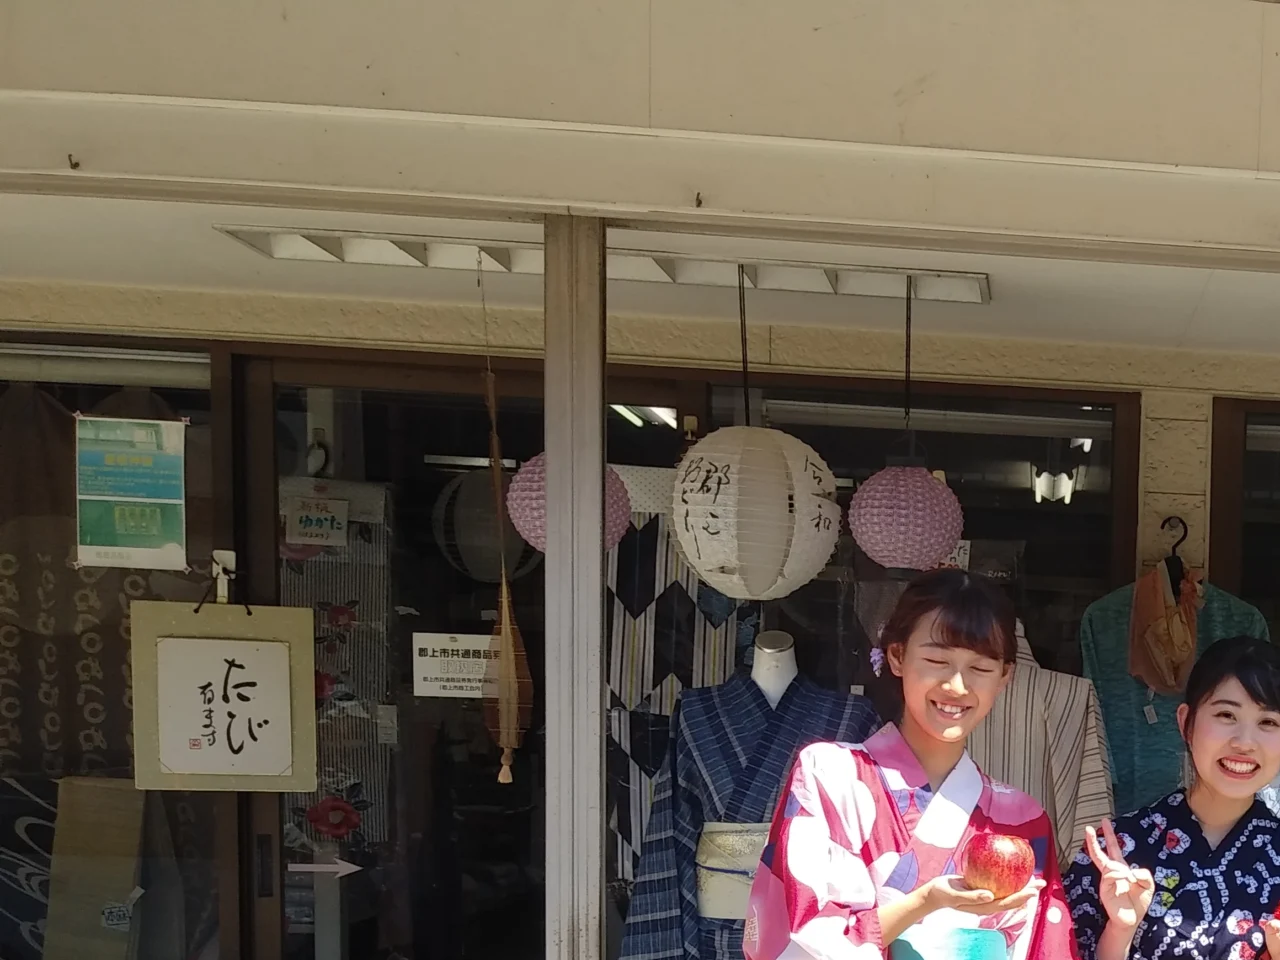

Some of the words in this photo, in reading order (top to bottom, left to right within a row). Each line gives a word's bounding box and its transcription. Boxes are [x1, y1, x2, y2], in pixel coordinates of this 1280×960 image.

[298, 514, 343, 531] ゆかた
[804, 455, 833, 533] 令和
[221, 657, 270, 756] たび
